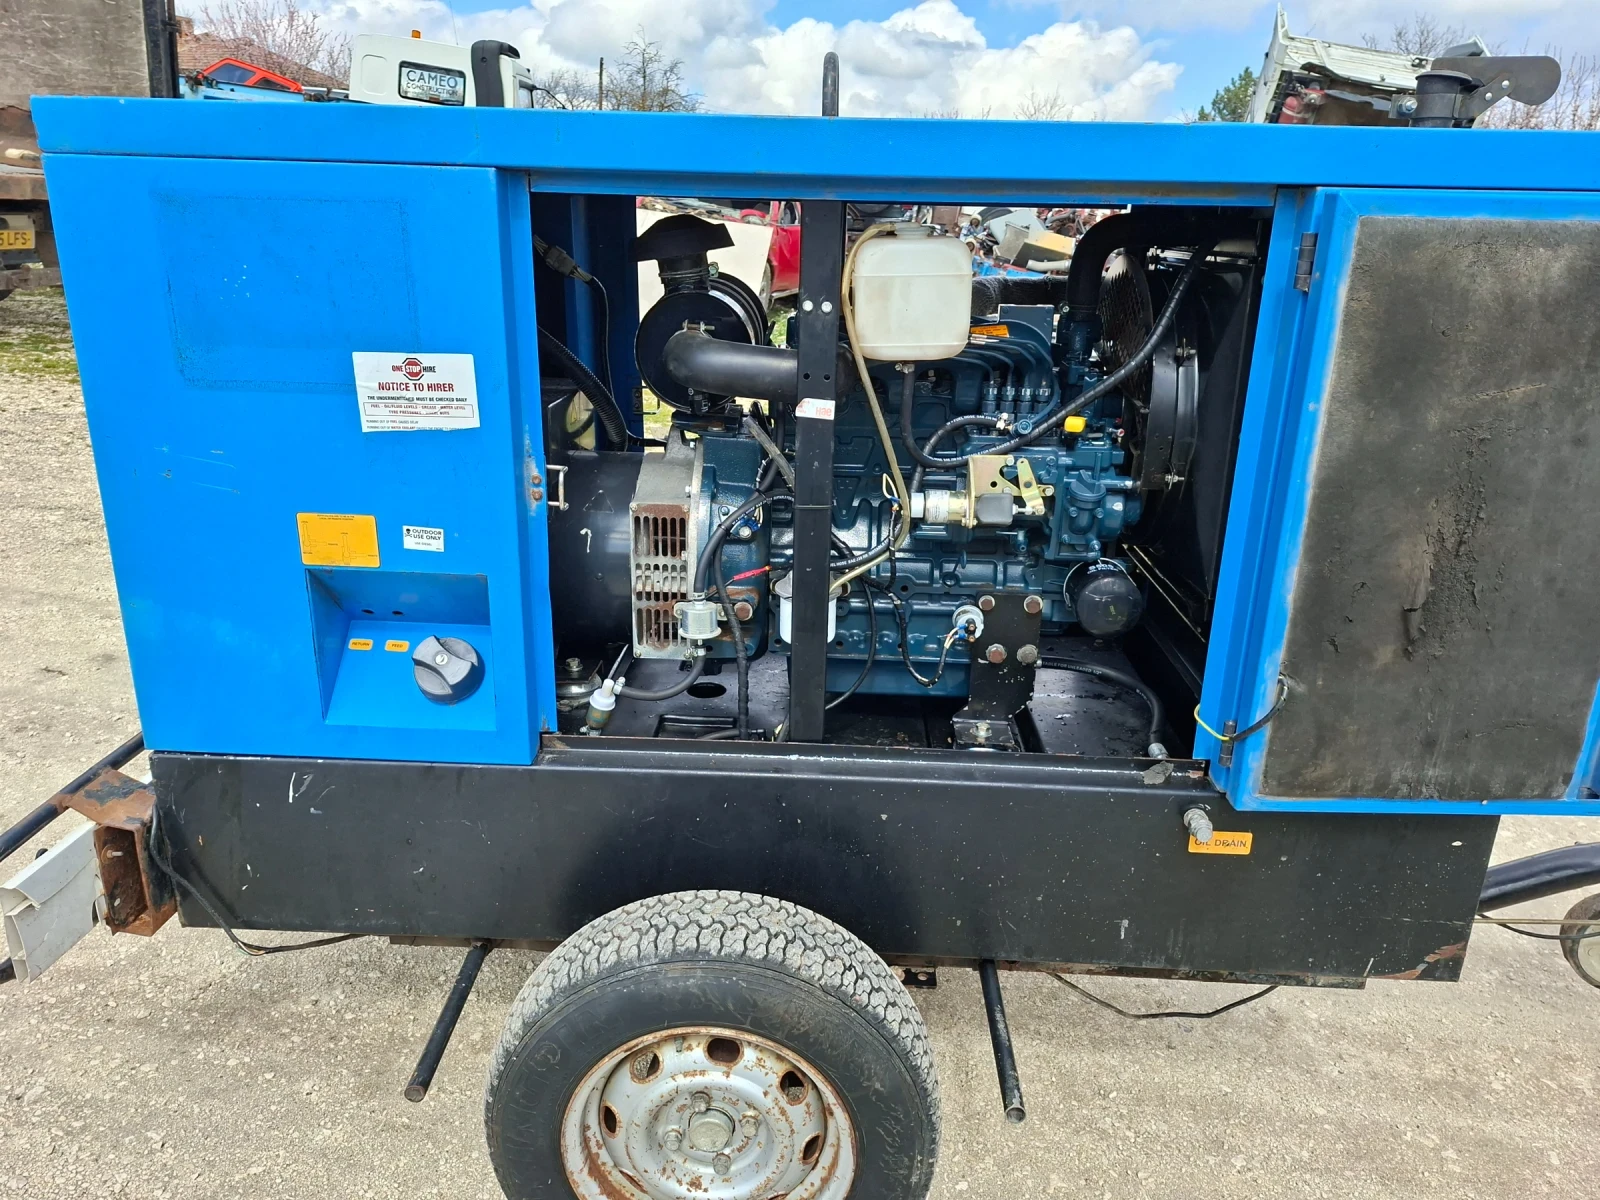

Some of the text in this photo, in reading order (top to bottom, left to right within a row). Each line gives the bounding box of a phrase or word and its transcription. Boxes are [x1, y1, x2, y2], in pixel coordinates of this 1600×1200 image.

[406, 69, 458, 88] CAMEO
[406, 82, 458, 96] CONSTRUCTION
[7, 231, 27, 246] LFS
[391, 364, 437, 373] ONE STOP HIRE
[378, 381, 454, 392] NOTICE TO HIRER
[412, 528, 442, 536] OUTDOOR
[1214, 839, 1247, 848] DRAIN
